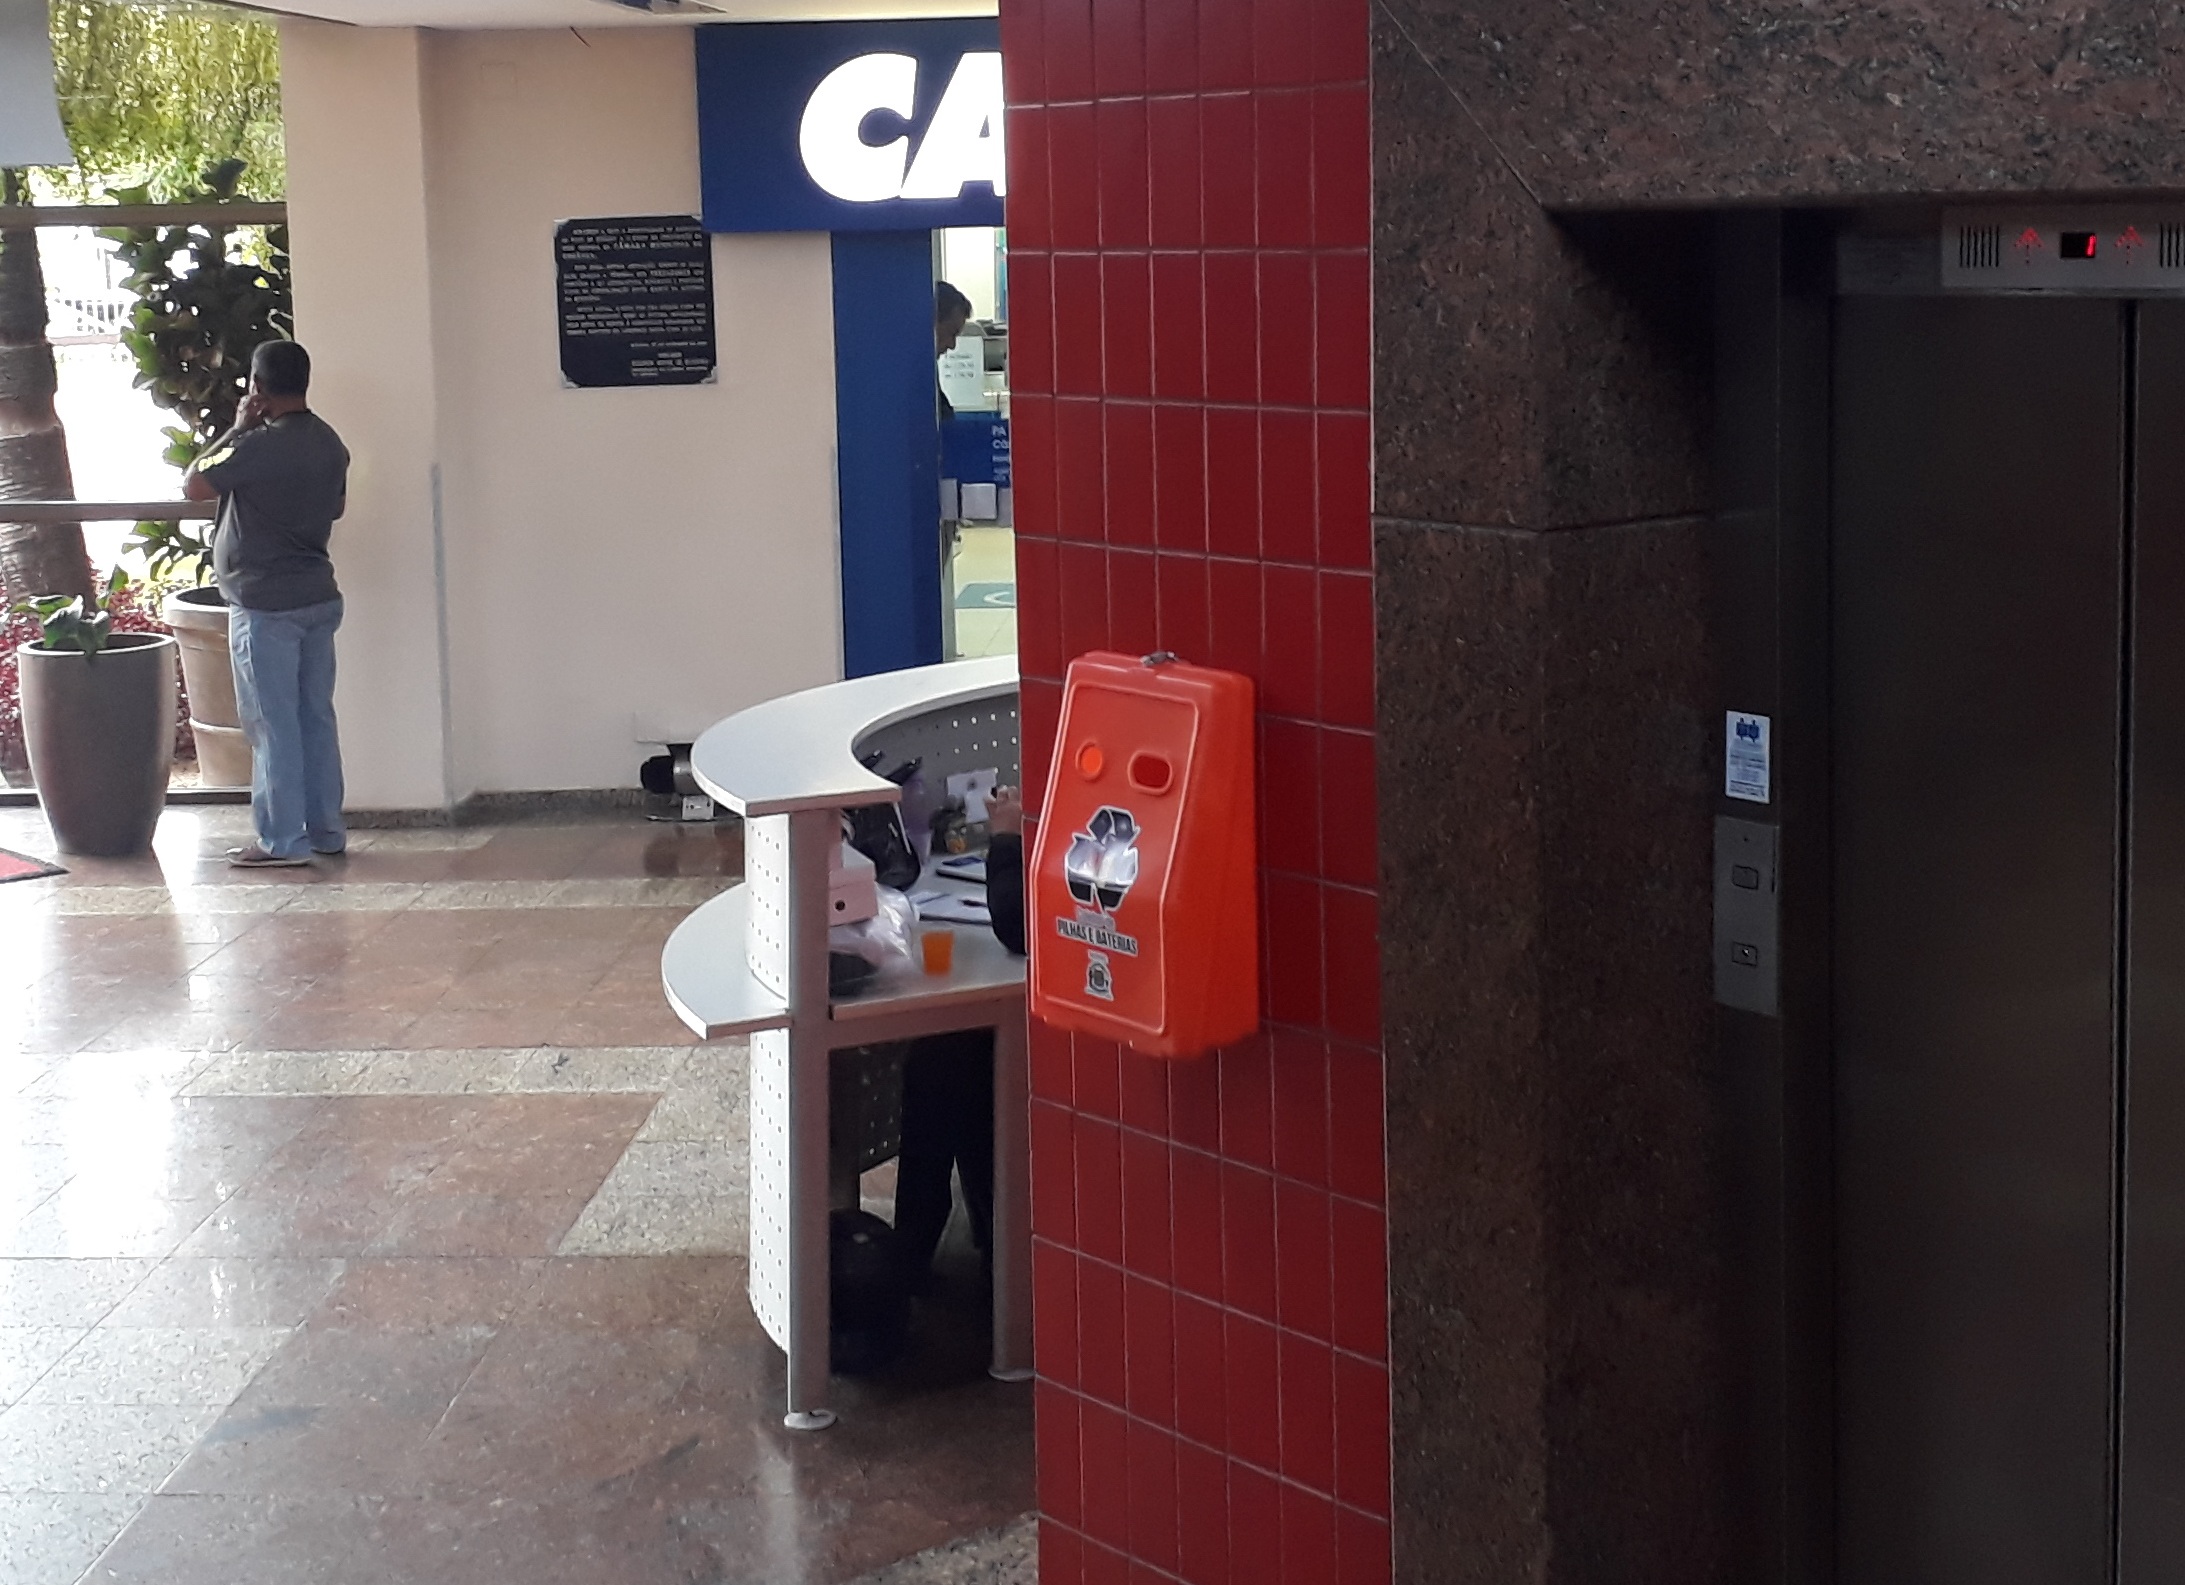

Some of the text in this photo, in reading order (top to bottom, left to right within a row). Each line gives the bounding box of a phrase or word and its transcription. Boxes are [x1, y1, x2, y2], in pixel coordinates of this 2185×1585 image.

[1058, 919, 1137, 954] PILHAS E BATERIAS
